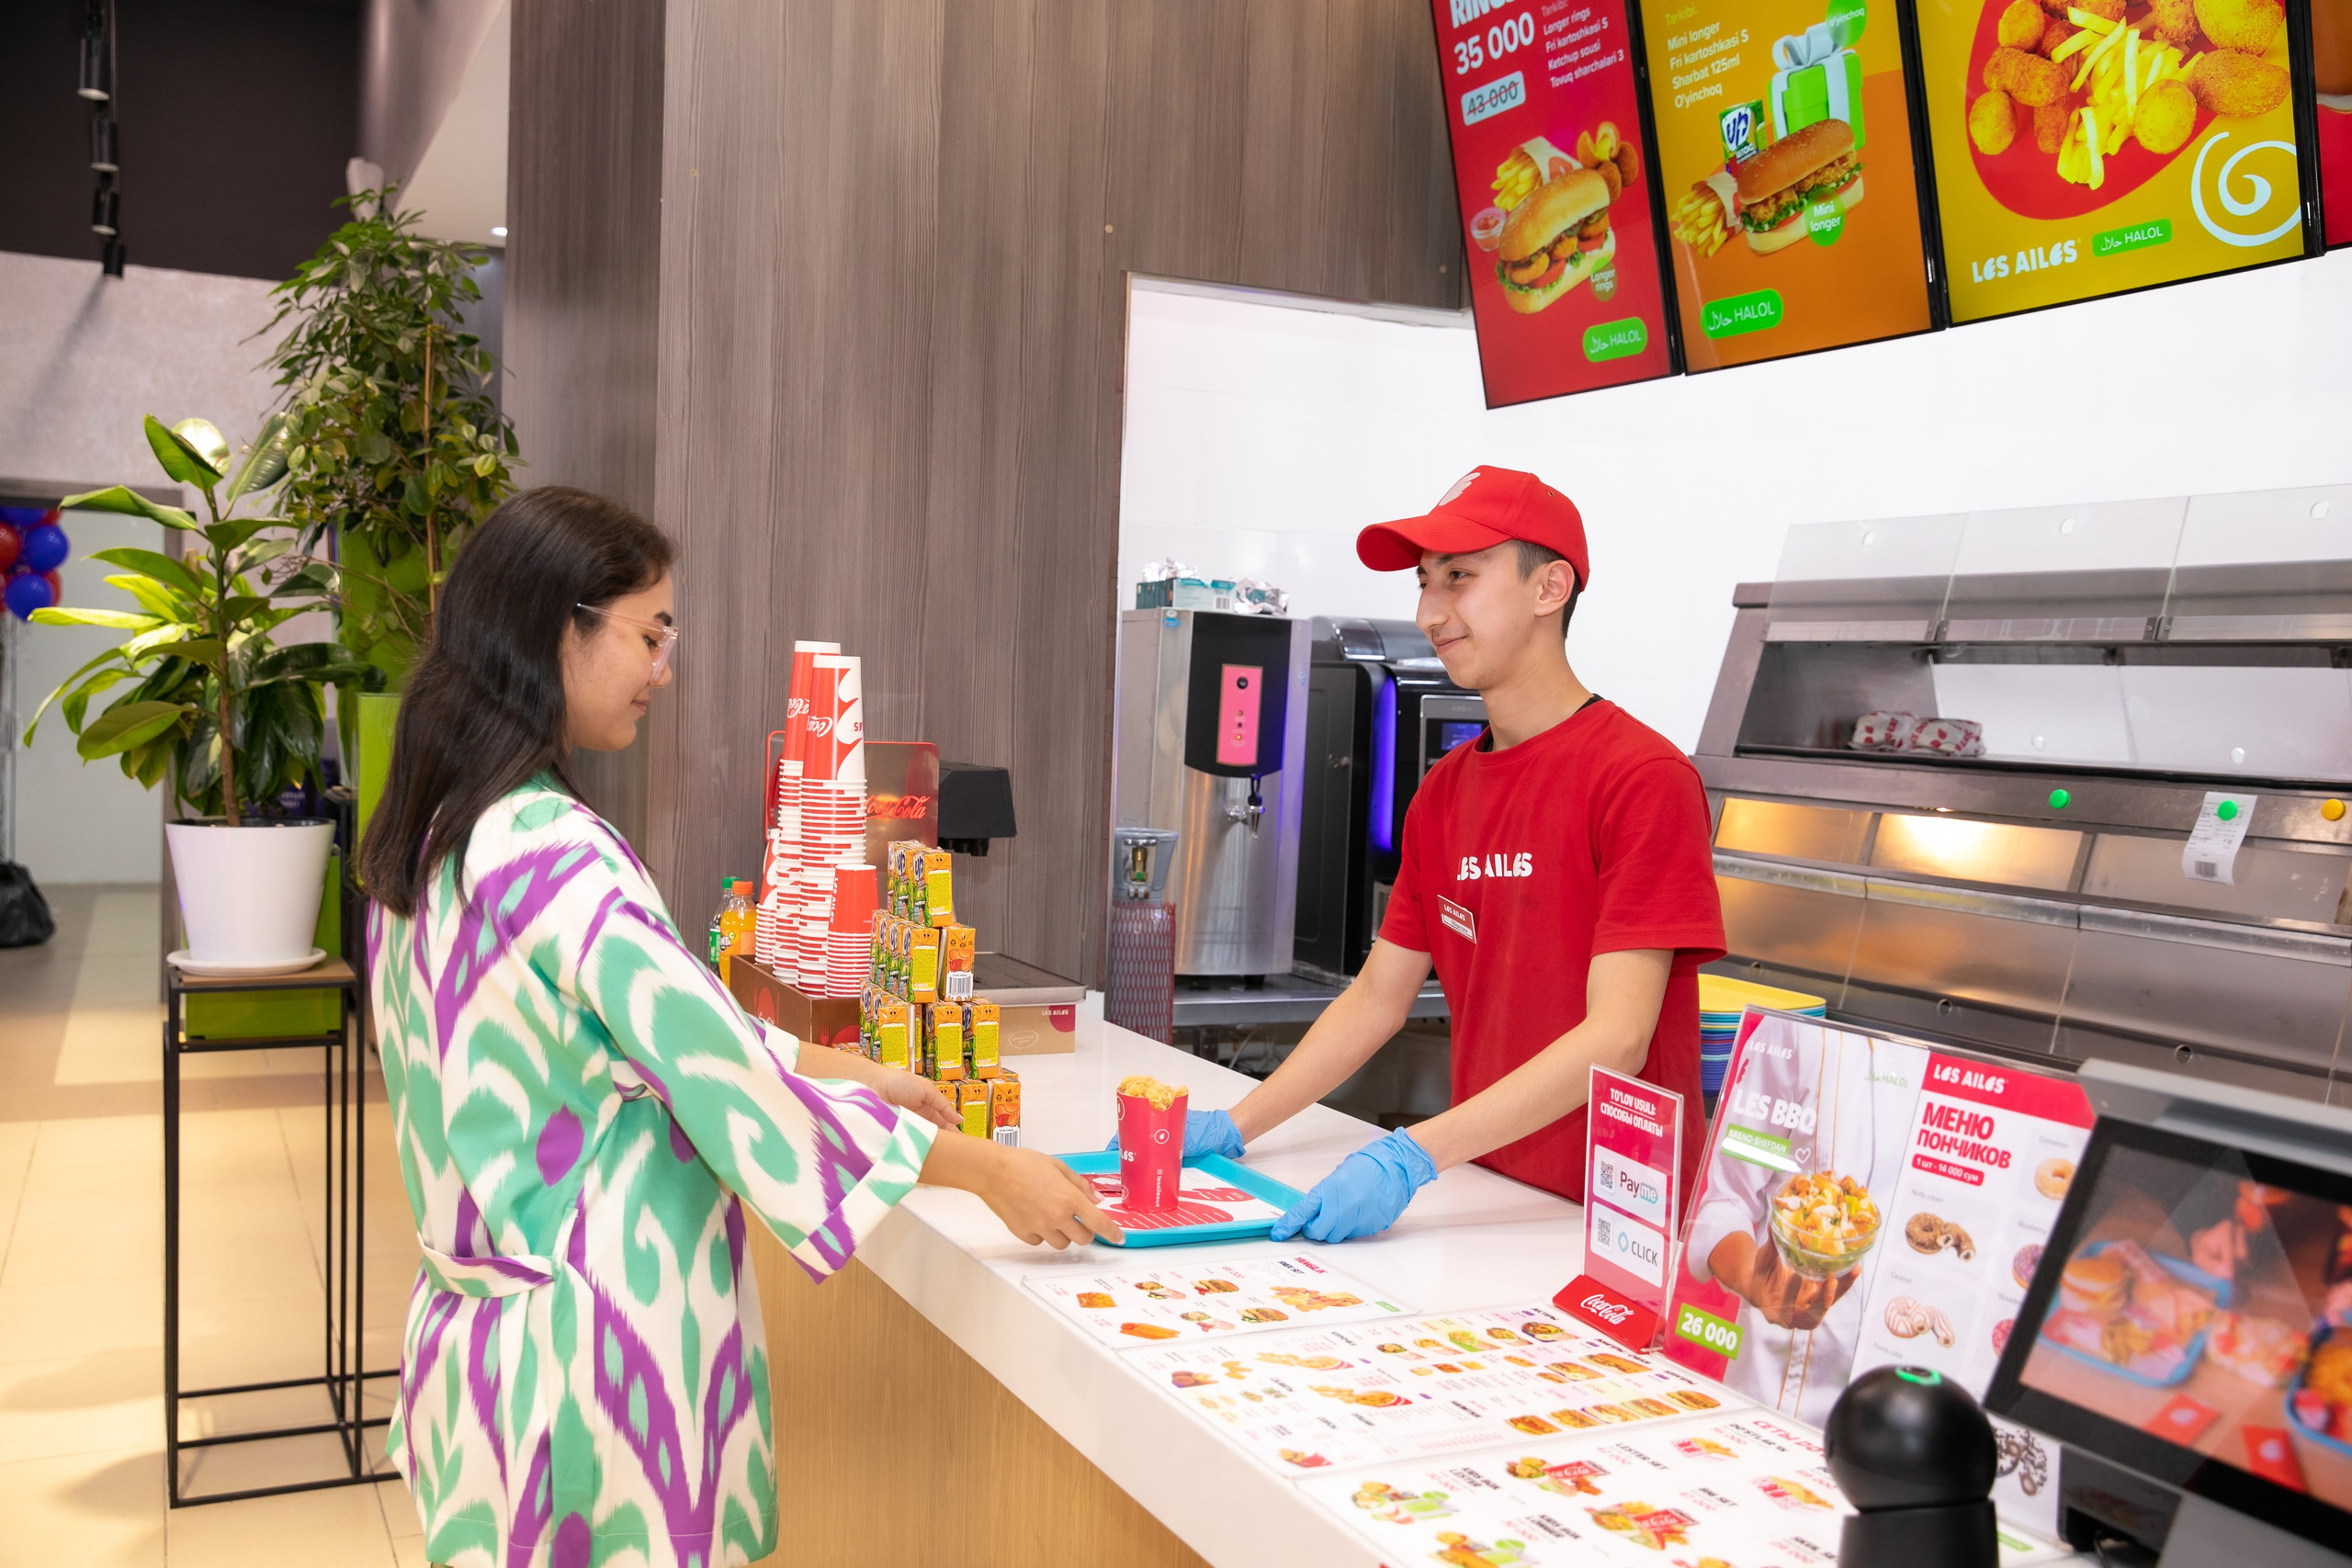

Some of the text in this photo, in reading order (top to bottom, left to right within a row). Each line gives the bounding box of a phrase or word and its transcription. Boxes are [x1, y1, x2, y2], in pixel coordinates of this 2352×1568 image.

[1544, 7, 1591, 36] Longer rings
[1667, 20, 1721, 51] Mini longer
[1453, 11, 1534, 74] 35 000
[1545, 39, 1556, 53] Fri
[1556, 22, 1601, 48] kartoshkasi
[1669, 28, 1749, 71] Fri kartoshkasi S
[1548, 39, 1600, 71] Ketchup sousi
[1550, 49, 1624, 88] Tovuq sharchalari 3
[1672, 54, 1740, 90] Sharbat 125ml
[1489, 81, 1519, 107] 000
[1810, 215, 1841, 232] longer
[1814, 201, 1835, 217] Mini
[2124, 225, 2163, 243] HALOL
[1972, 239, 2078, 283] LES AILES
[1590, 268, 1616, 285] Longer
[1595, 279, 1612, 292] rings
[1734, 301, 1775, 320] HALOL
[1609, 329, 1642, 347] HALOL
[1484, 852, 1532, 878] AILES
[1882, 1074, 1908, 1088] HALOL
[1933, 1064, 2005, 1094] LES AILES
[1610, 1088, 1634, 1107] TO'LOV
[1600, 1101, 1663, 1138] СПОСОБЫ ОПЛАТЫ
[1732, 1089, 1817, 1136] LES BBQ
[1922, 1101, 1995, 1141] МЕНЮ
[1917, 1128, 2012, 1169] ПОНЧИКОВ
[1917, 1157, 1921, 1166] 1
[1921, 1161, 1933, 1169] шт
[1939, 1164, 1947, 1173] 14
[1948, 1167, 1963, 1178] 000
[1963, 1171, 1979, 1182] сум
[1631, 1241, 1658, 1266] CLICK
[1681, 1313, 1737, 1351] 26 000
[1615, 1443, 1650, 1461] LESTER
